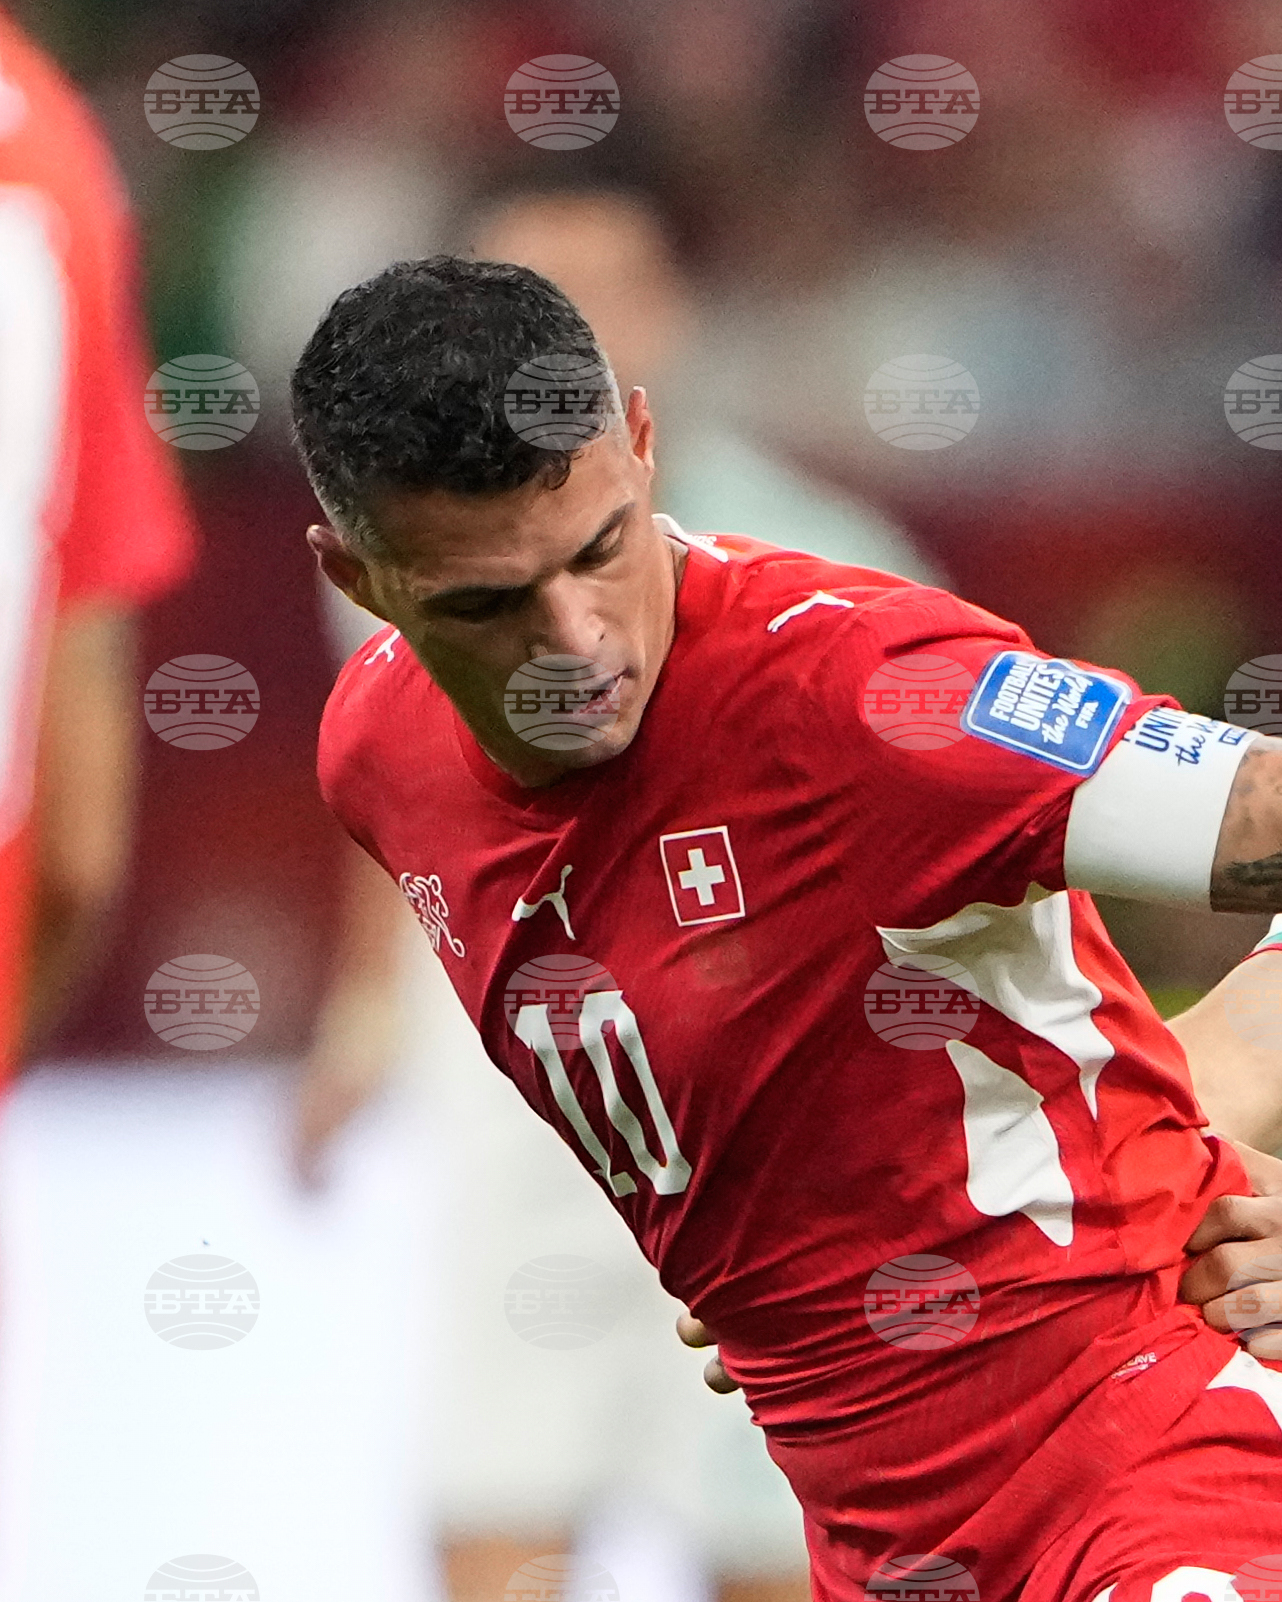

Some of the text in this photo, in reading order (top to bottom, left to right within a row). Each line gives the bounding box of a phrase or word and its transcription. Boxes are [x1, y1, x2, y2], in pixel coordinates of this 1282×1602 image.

[989, 661, 1036, 722] FOOTBALL
[1010, 664, 1065, 732] UNITES
[1042, 675, 1094, 745] the World
[1075, 701, 1099, 730] FIFA
[514, 990, 692, 1197] 10
